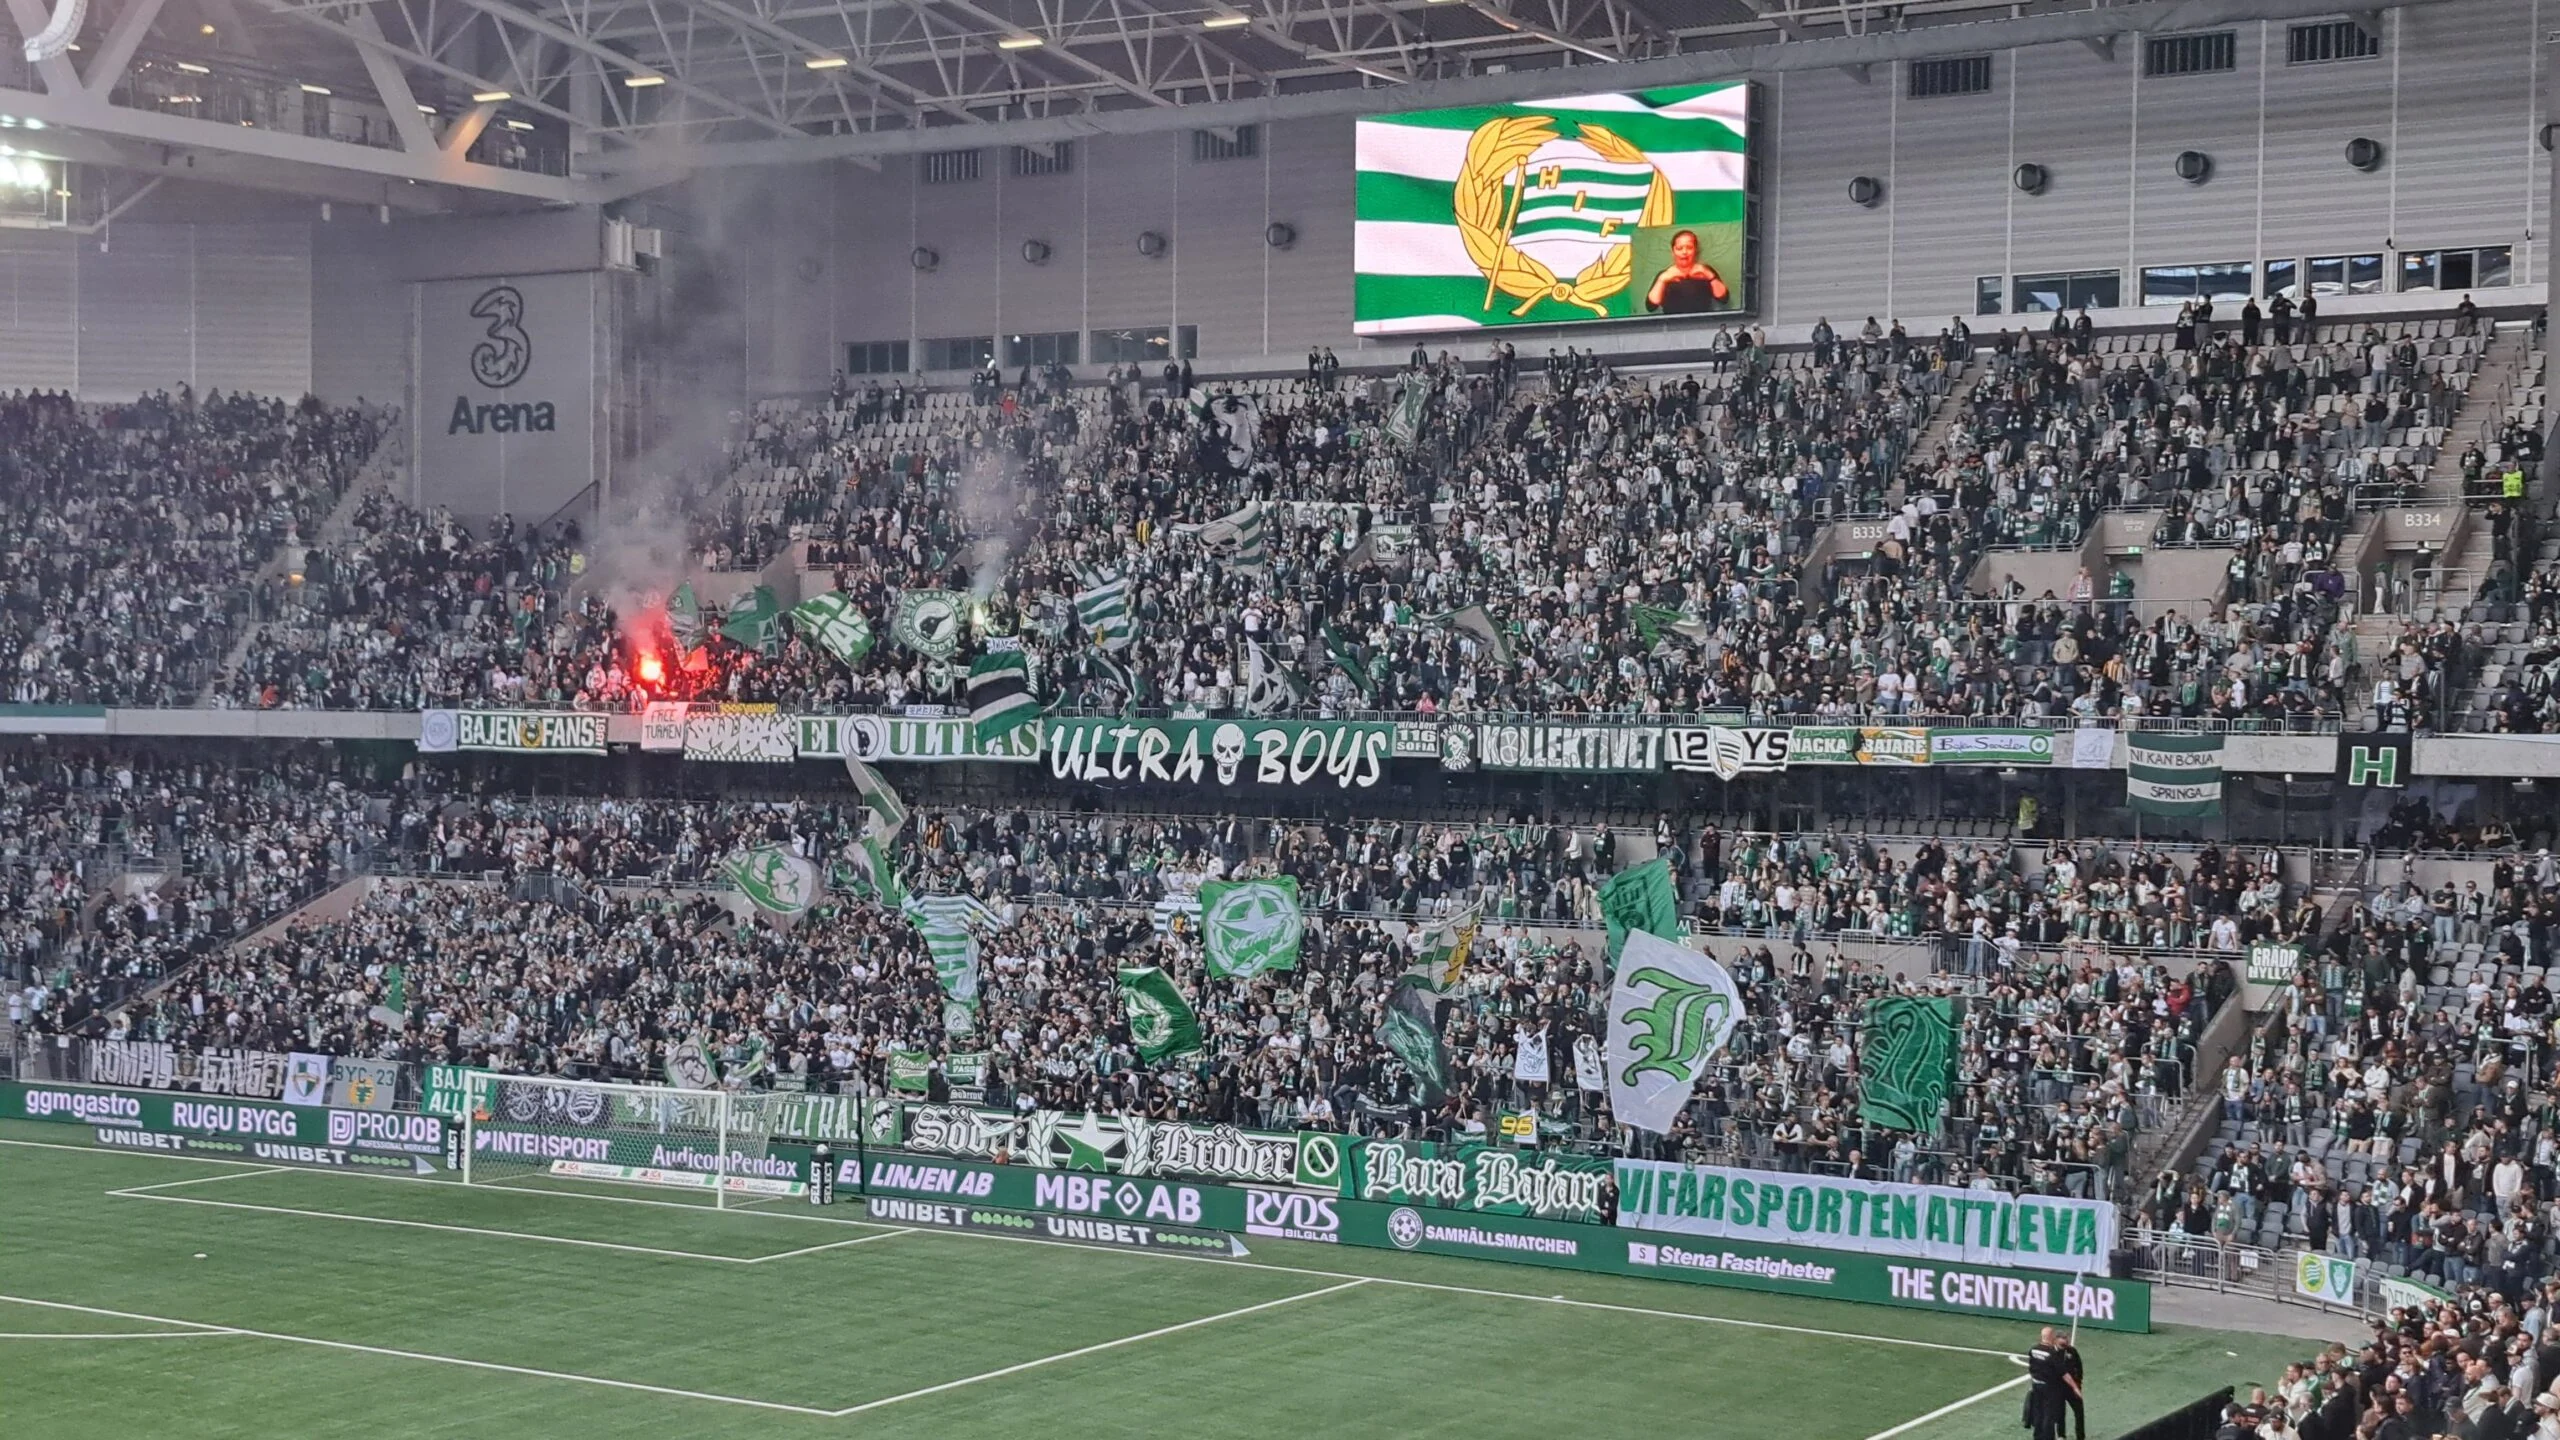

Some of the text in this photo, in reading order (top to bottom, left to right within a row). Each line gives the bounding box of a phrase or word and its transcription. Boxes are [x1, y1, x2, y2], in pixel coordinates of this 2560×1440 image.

[470, 286, 531, 388] 3
[448, 395, 556, 435] Arena
[1852, 526, 1884, 541] B335
[2404, 513, 2441, 527] B334
[459, 715, 522, 746] BAJEN
[542, 716, 594, 747] FANS
[889, 719, 1038, 757] ULTRAS
[1397, 742, 1435, 752] SOFIA
[1398, 730, 1437, 742] 116
[1482, 725, 1663, 769] KOLLEKTIVET
[1672, 730, 1789, 761] 12 YS
[1789, 737, 1927, 754] NACKA BAJARE
[1049, 722, 1388, 789] ULTRA BOYS
[2130, 748, 2143, 761] NI
[2147, 751, 2173, 765] KAN
[2348, 746, 2397, 787] H
[90, 1039, 286, 1097] KOMPIS GÄNGET
[25, 1089, 141, 1119] ggmgastro
[173, 1102, 234, 1131] RUGU
[238, 1107, 297, 1137] BYGG
[99, 1128, 184, 1150] UNIBET
[356, 1111, 441, 1143] PROJOB
[910, 1102, 1295, 1182] Söder Bröder
[1499, 1115, 1533, 1136] 96
[254, 1143, 347, 1165] UNIBET
[447, 1129, 458, 1170] SELECT
[492, 1130, 610, 1160] INTERSPORT
[652, 1144, 798, 1178] AudicomPendax
[810, 1161, 821, 1205] SELECT
[823, 1161, 833, 1205] SELECT
[870, 1162, 954, 1192] LINJEN
[956, 1168, 995, 1197] AB
[1364, 1142, 1465, 1200] Bara
[871, 1198, 968, 1226] UNIBET
[1035, 1172, 1202, 1222] MBF AB
[1246, 1190, 1340, 1230] RYDS
[1047, 1216, 1151, 1246] UNIBET
[1284, 1228, 1338, 1243] BILGLAS
[1424, 1225, 1579, 1256] SAMHÄLLSMATCHEN
[1659, 1245, 1720, 1270] Stena
[1719, 1251, 1836, 1283] Fastigheter
[1887, 1265, 2115, 1321] THE CENTRAL BAR
